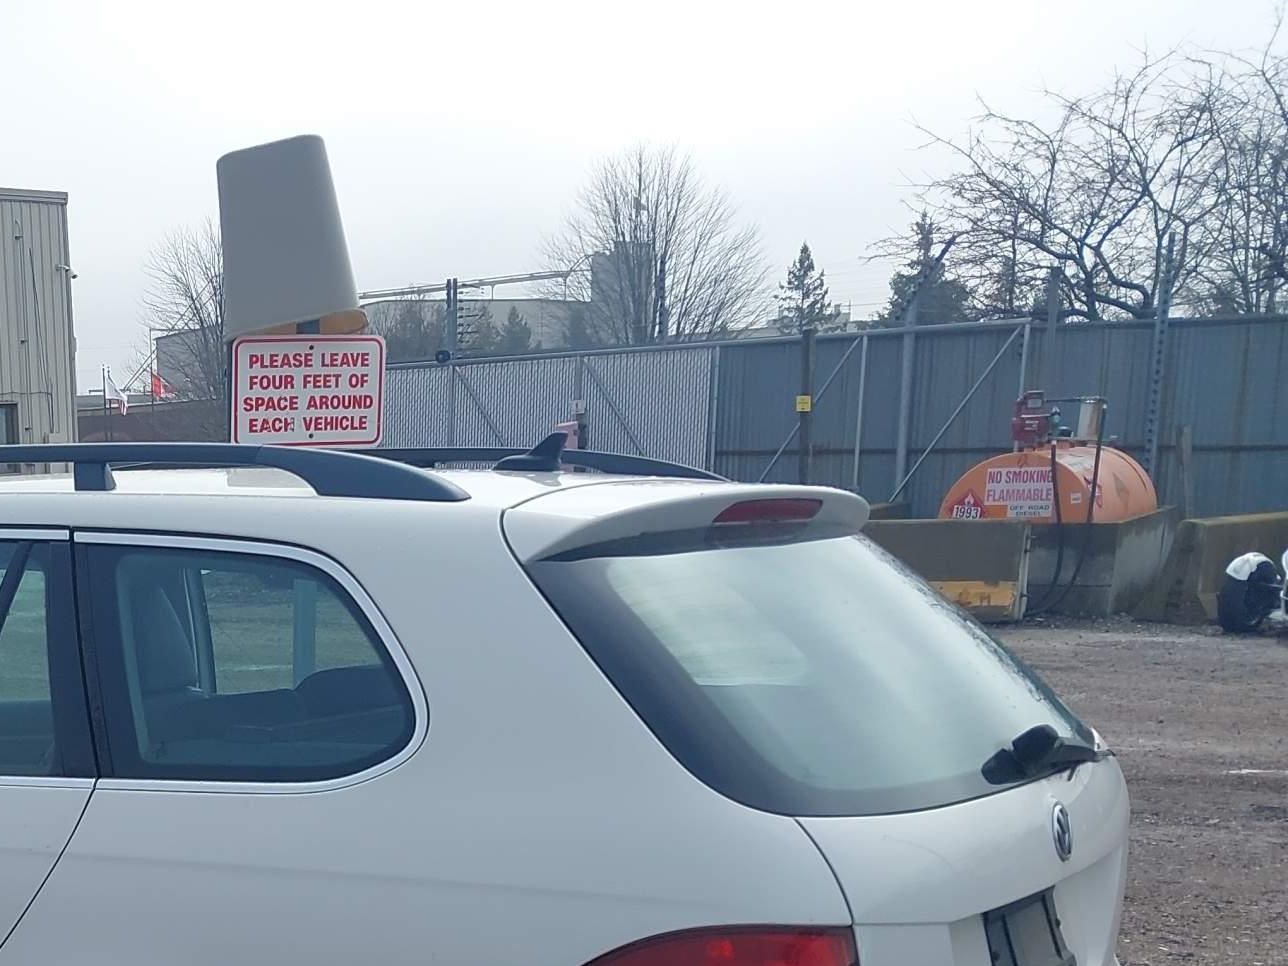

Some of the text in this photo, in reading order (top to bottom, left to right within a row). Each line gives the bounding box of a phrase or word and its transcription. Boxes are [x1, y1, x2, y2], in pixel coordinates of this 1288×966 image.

[249, 352, 370, 369] PLEASE LEAVE
[249, 373, 369, 391] FOUR FEET OF
[243, 394, 373, 412] SPACE AROUND
[248, 416, 367, 434] EACH VEHICLE
[988, 469, 1053, 484] NO SMOKING
[986, 488, 1052, 502] FLAMMABLE
[955, 506, 979, 519] 1993
